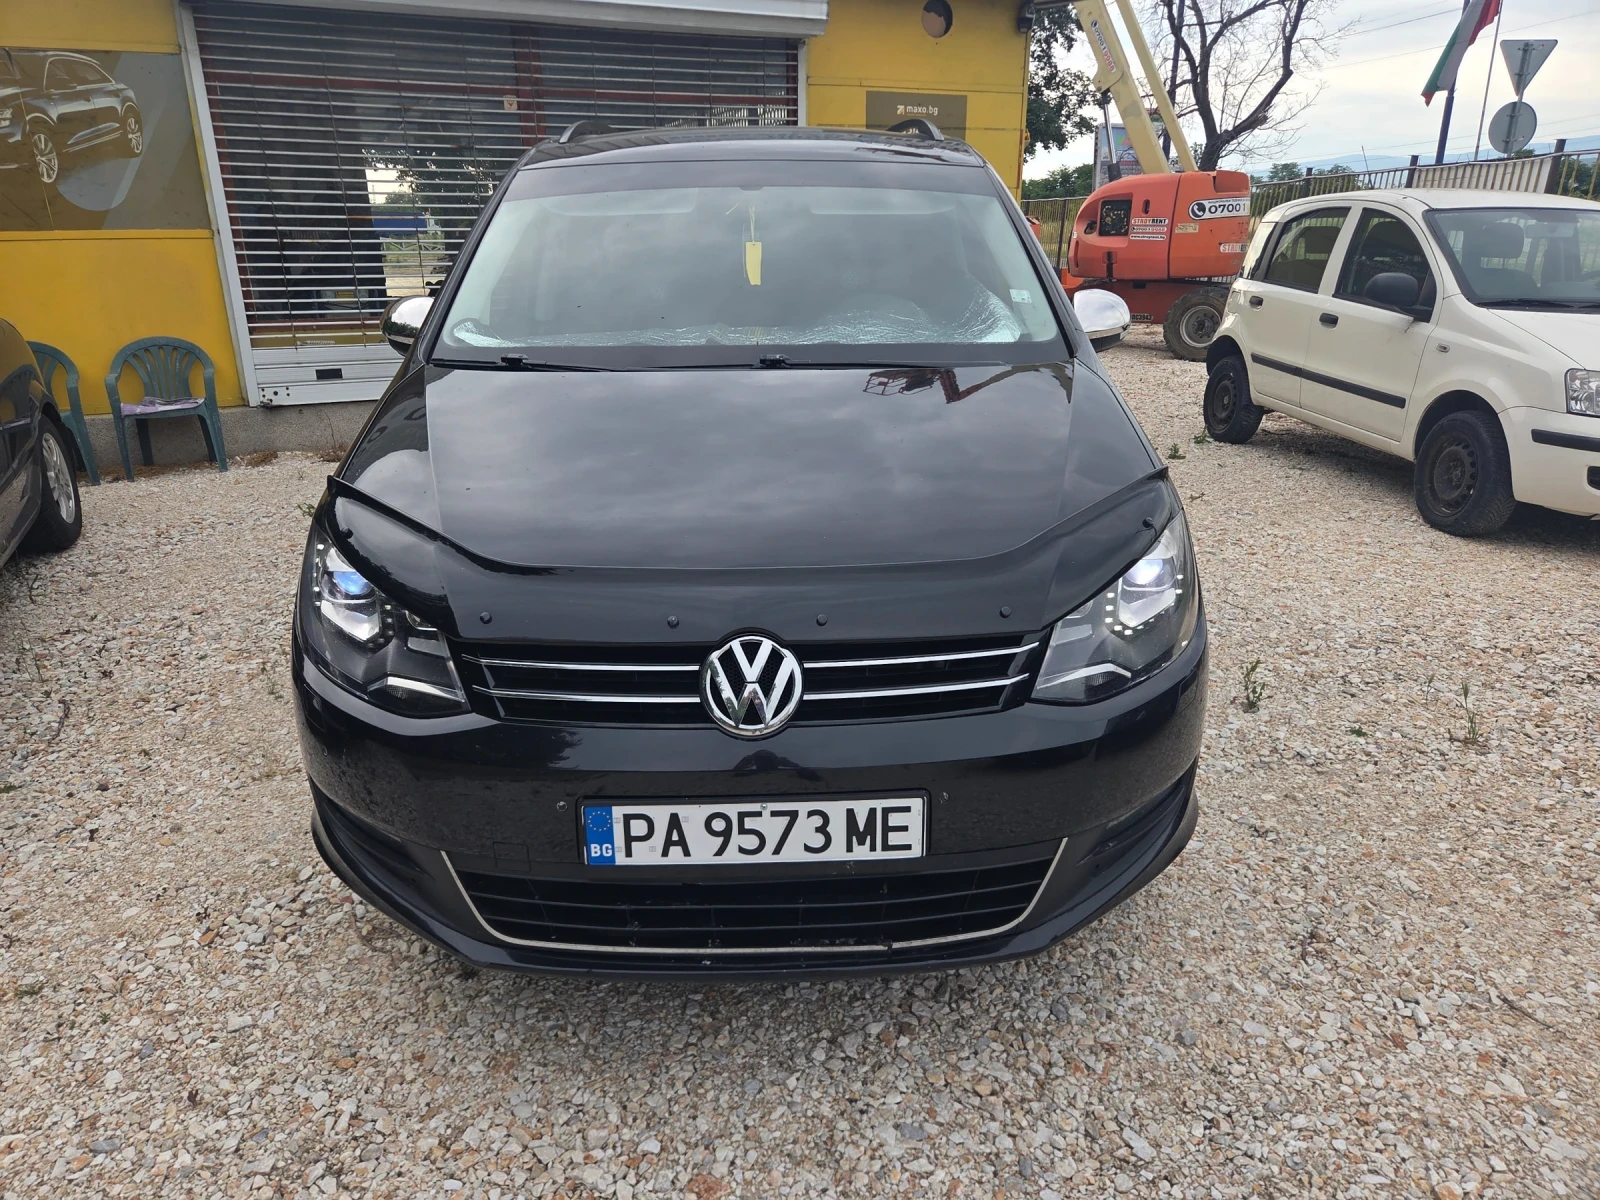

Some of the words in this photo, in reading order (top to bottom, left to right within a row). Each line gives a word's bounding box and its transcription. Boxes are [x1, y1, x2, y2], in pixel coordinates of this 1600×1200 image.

[906, 105, 938, 116] maxo.bg
[623, 812, 692, 858] PA
[704, 810, 832, 857] 9573
[845, 805, 913, 853] ME
[590, 843, 613, 857] BG
